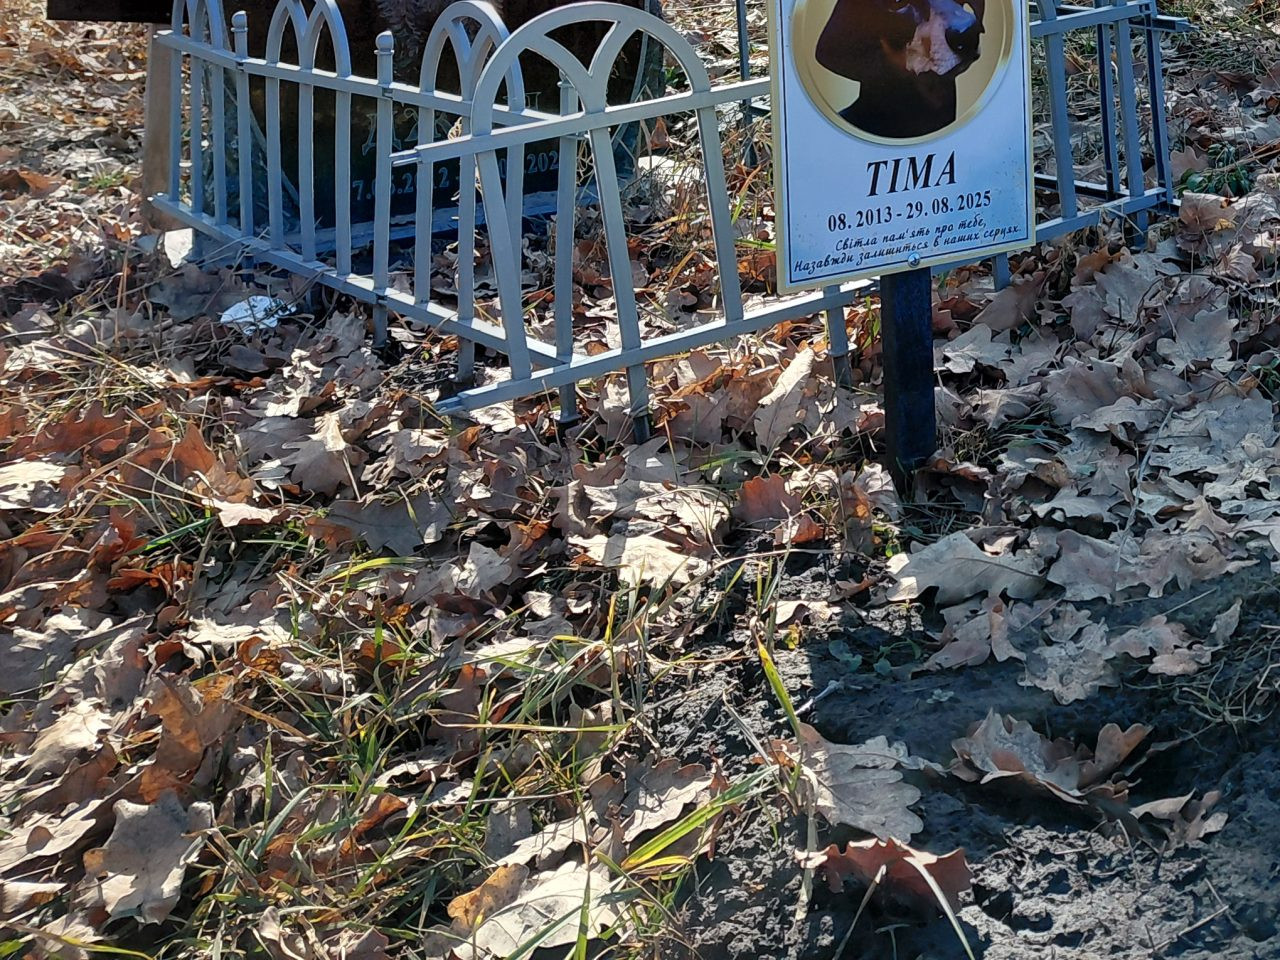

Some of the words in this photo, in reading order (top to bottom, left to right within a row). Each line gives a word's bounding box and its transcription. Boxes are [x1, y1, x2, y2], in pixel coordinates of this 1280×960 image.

[866, 150, 957, 197] ТІМА
[794, 253, 854, 275] Назавжди
[855, 240, 929, 266] залишиться
[933, 232, 940, 248] в
[943, 231, 980, 246] наших
[836, 237, 877, 251] Світла
[935, 223, 954, 238] про
[958, 213, 987, 231] тебе,
